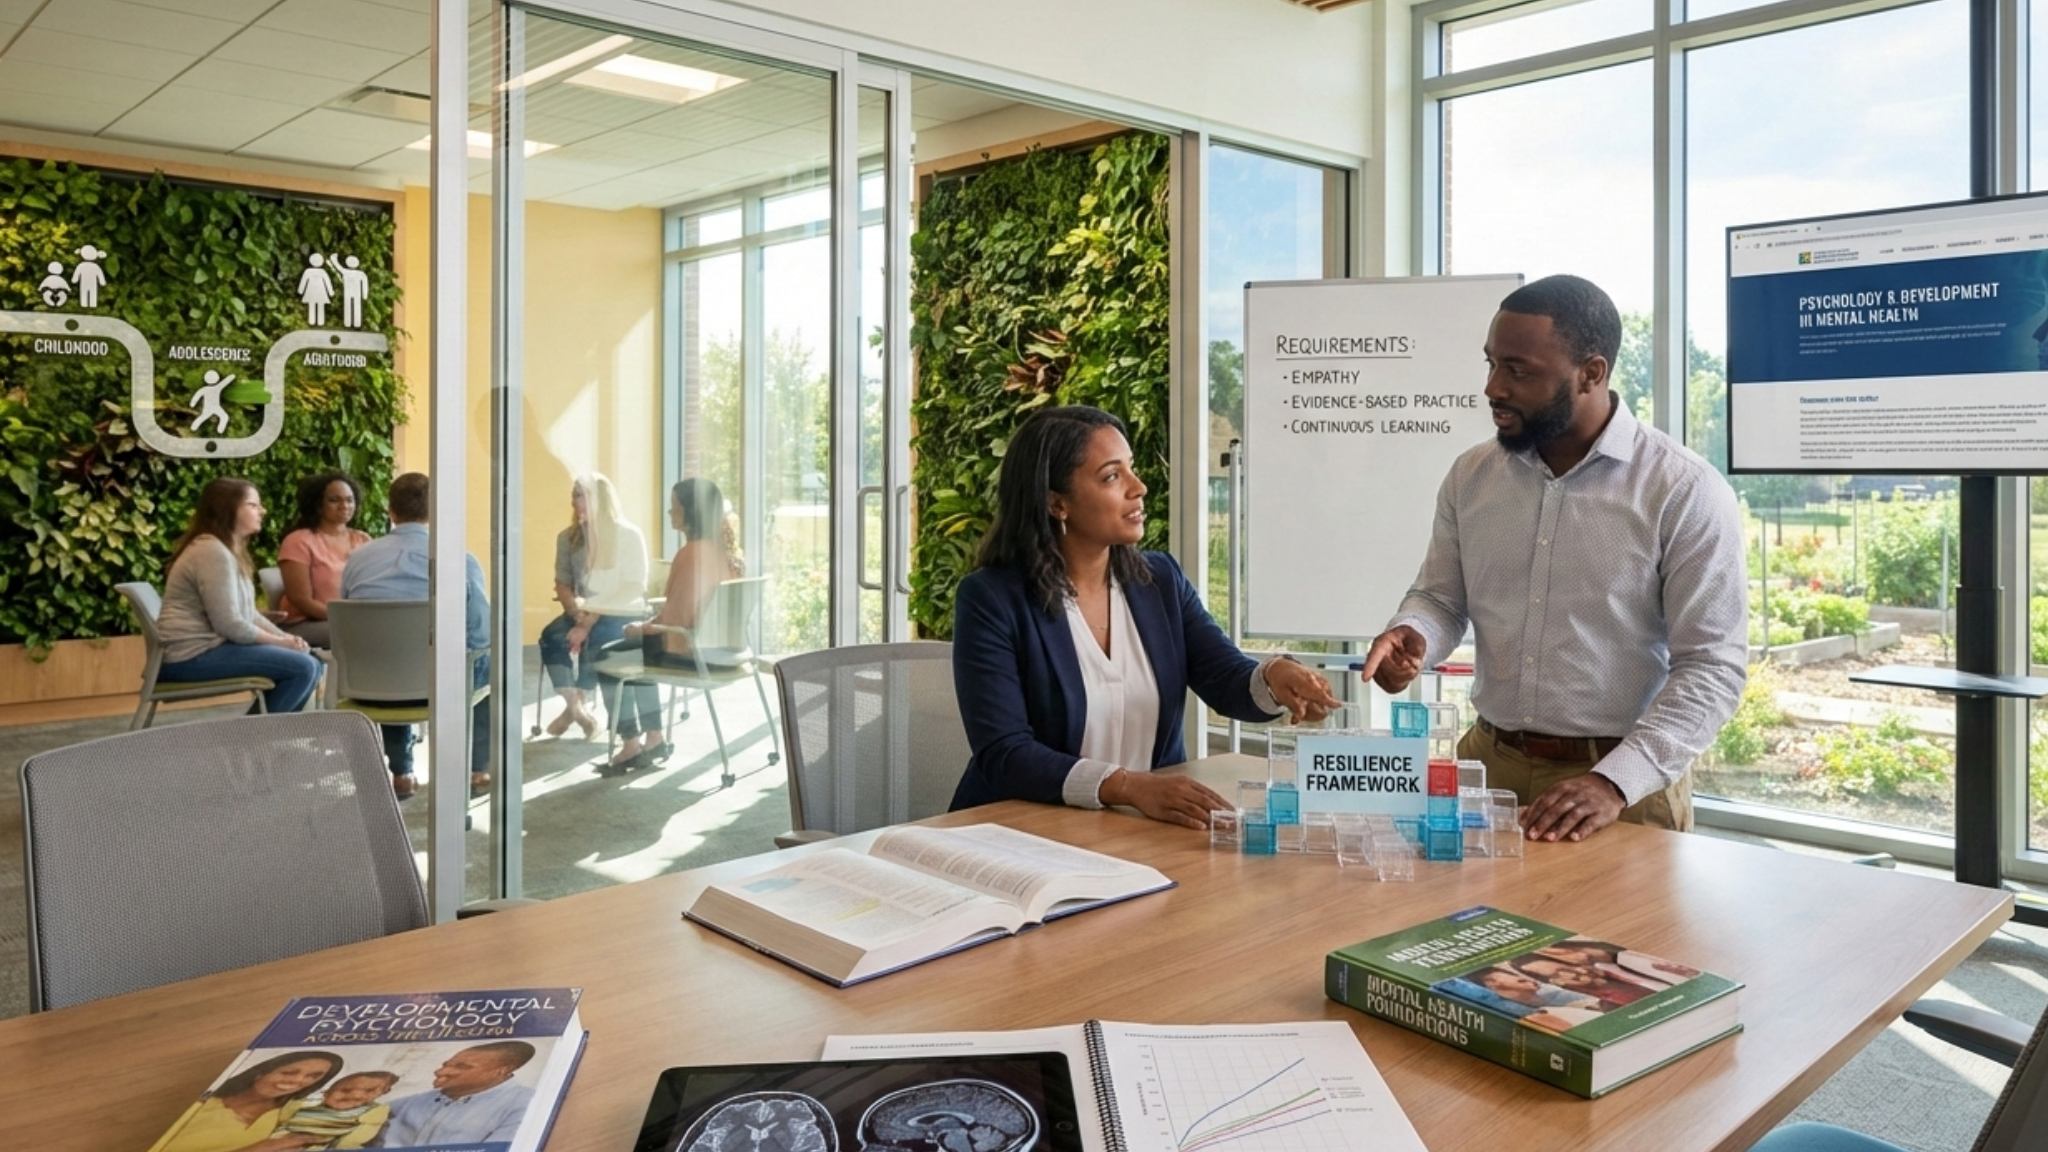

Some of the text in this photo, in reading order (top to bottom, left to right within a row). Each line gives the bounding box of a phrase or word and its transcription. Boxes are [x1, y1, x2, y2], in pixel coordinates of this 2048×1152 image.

[1276, 335, 1416, 354] REQUIREMENTS:
[1291, 370, 1360, 384] EMPATHY
[1413, 395, 1478, 408] PRACTICE
[1291, 420, 1451, 434] CONTINUOUS LEARNING
[1313, 754, 1412, 772] RESILIENCE
[1306, 774, 1420, 793] FRAMEWORK
